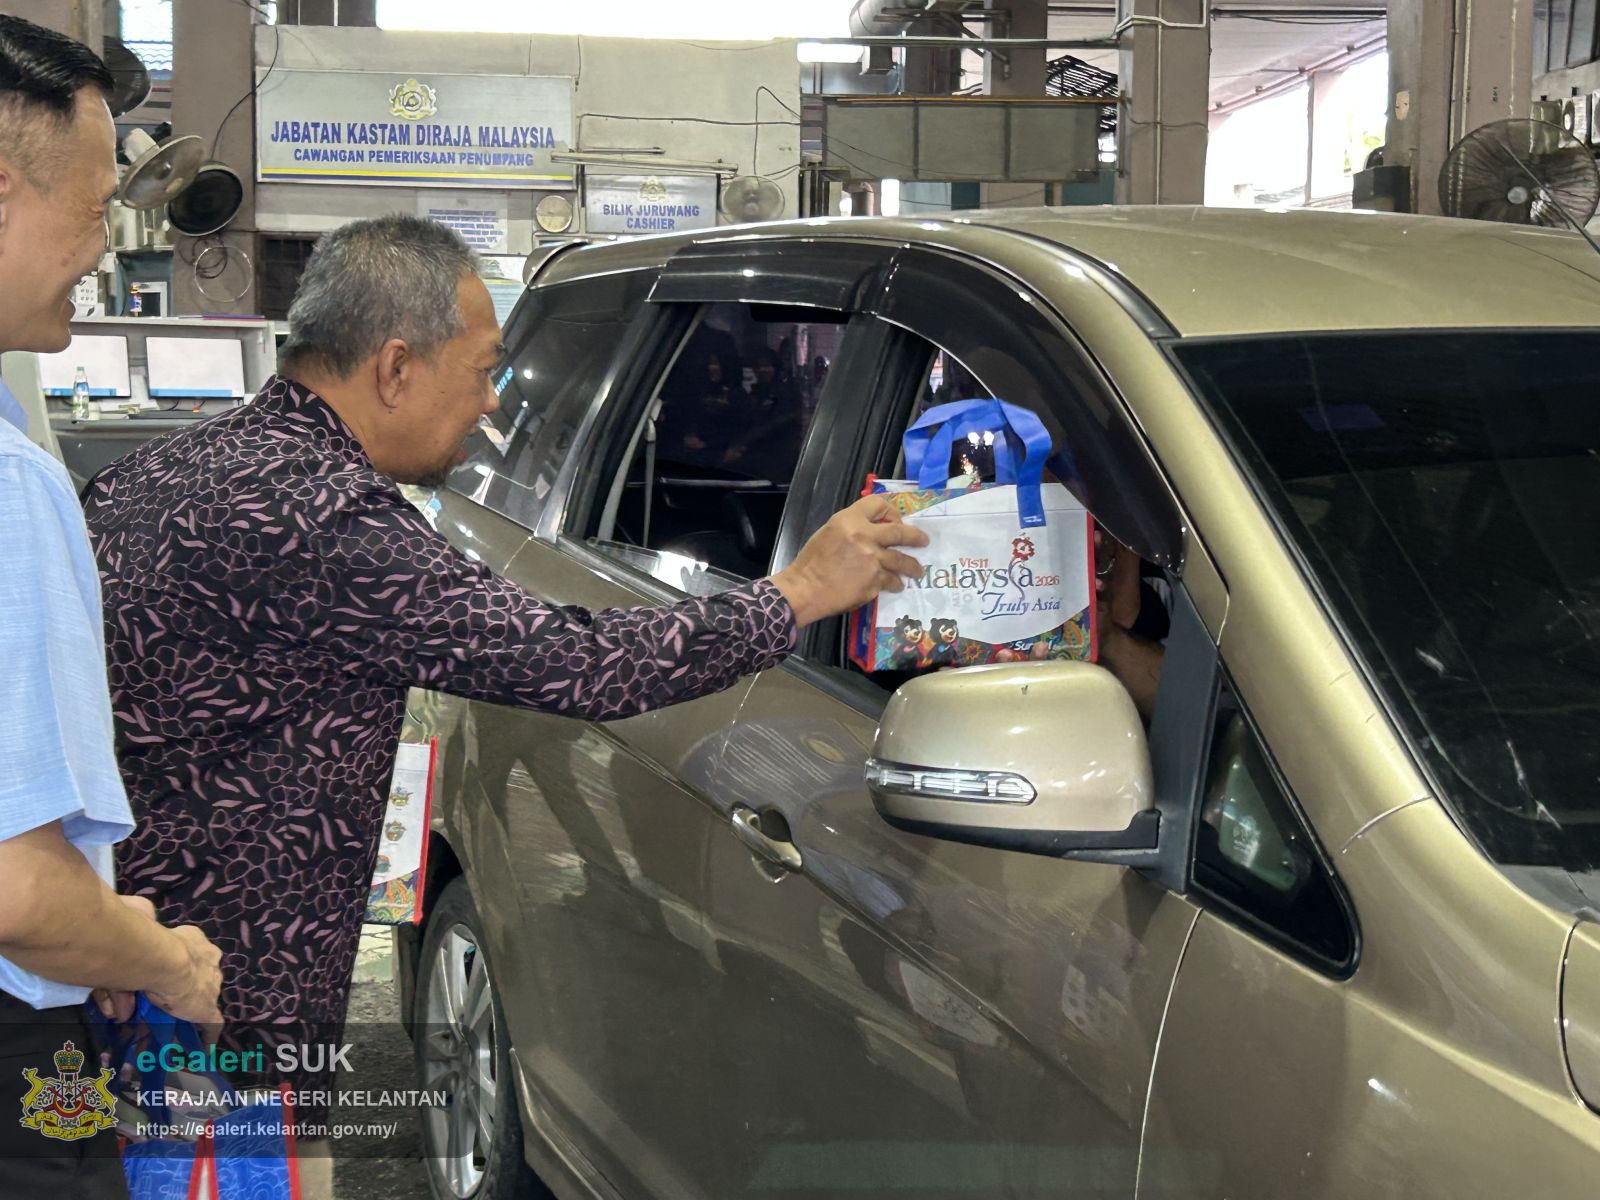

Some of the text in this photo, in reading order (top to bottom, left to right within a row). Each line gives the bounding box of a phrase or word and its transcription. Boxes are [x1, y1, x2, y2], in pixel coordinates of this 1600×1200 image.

[271, 121, 555, 148] JABATAN KASTAM DIRAJA MALAYSIA
[294, 149, 534, 166] CAWANGAN PEMERIKSAAN PENUMPANG
[603, 204, 700, 217] BILIK JURUWANG
[627, 218, 675, 229] CASHIER
[1035, 576, 1060, 587] 2026
[981, 592, 1030, 620] Truly
[1031, 598, 1062, 613] Asia
